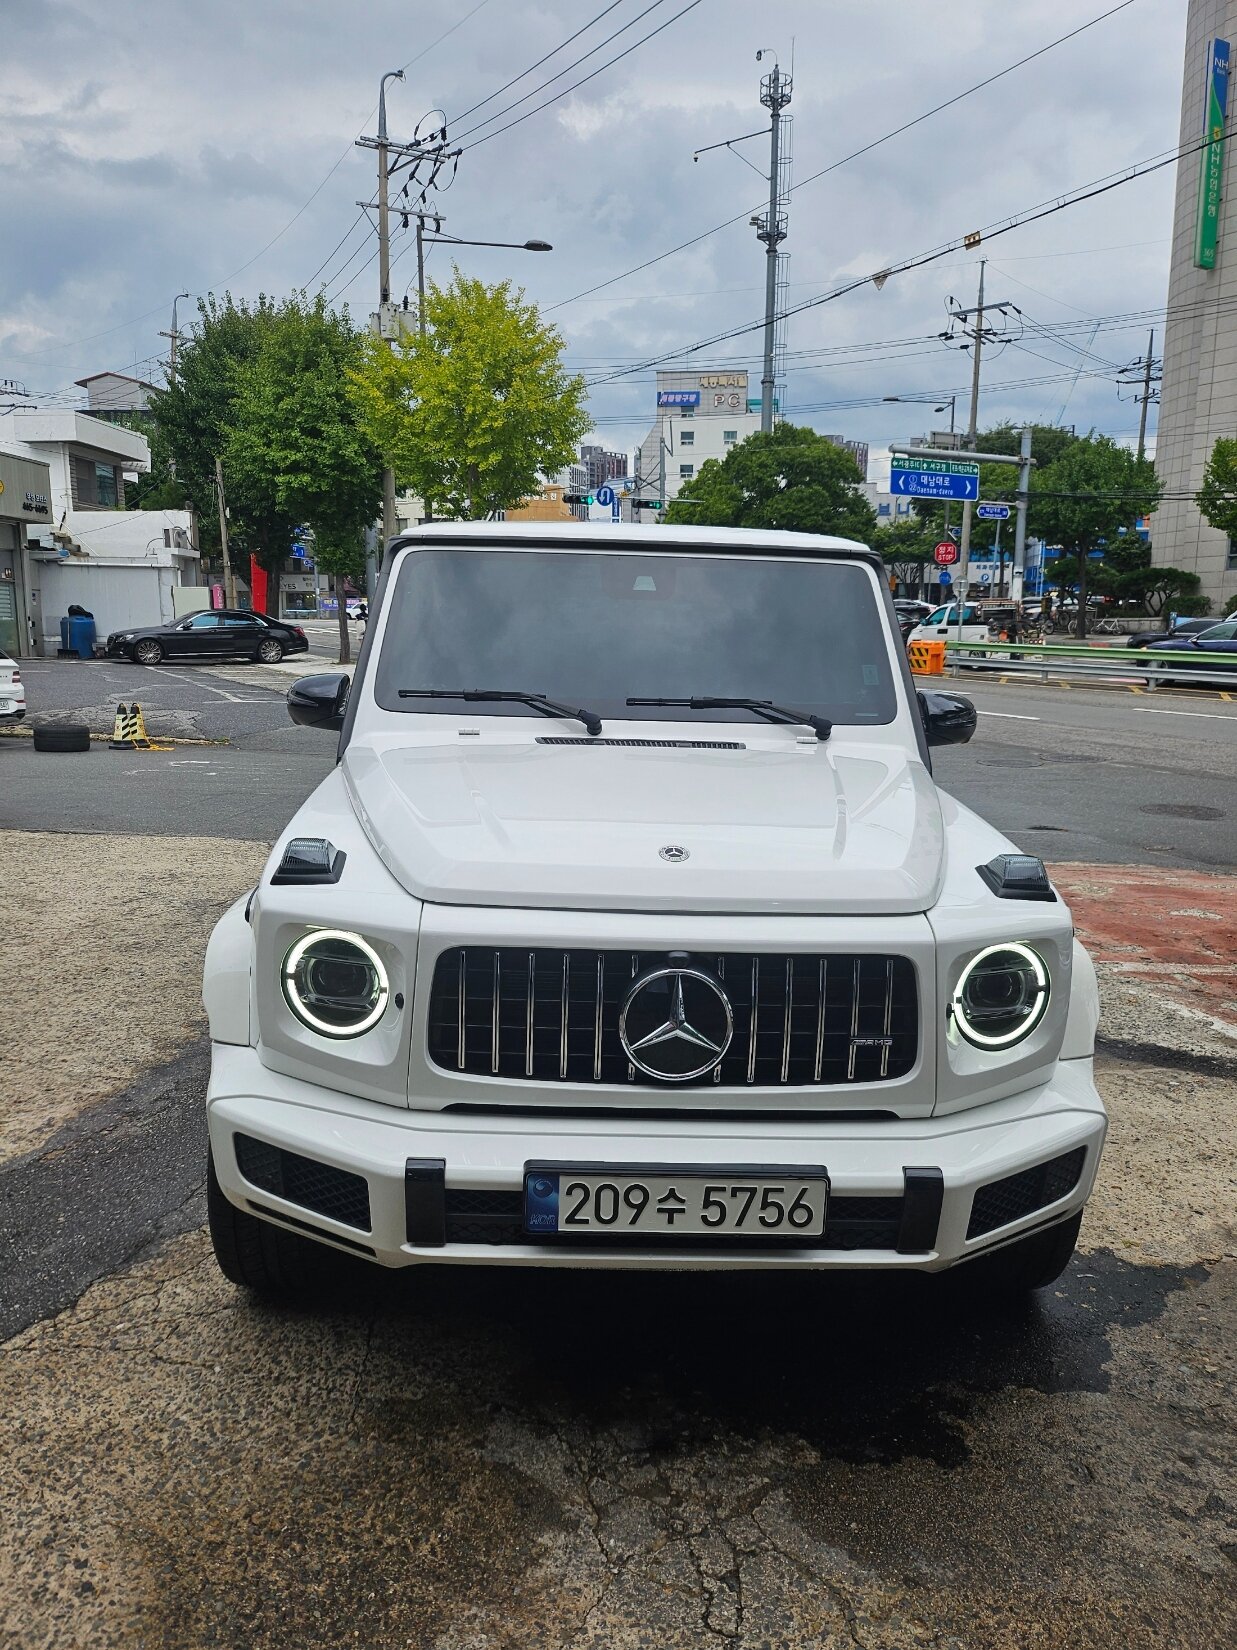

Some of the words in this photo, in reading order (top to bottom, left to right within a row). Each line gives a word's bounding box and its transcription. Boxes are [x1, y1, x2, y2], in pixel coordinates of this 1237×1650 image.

[1215, 57, 1229, 70] NH
[713, 394, 740, 407] PC
[920, 475, 950, 487] 대남대로
[916, 486, 954, 496] Daenam-daero
[938, 546, 954, 555] 정지
[564, 1181, 687, 1226] 209수
[700, 1185, 815, 1229] 5756
